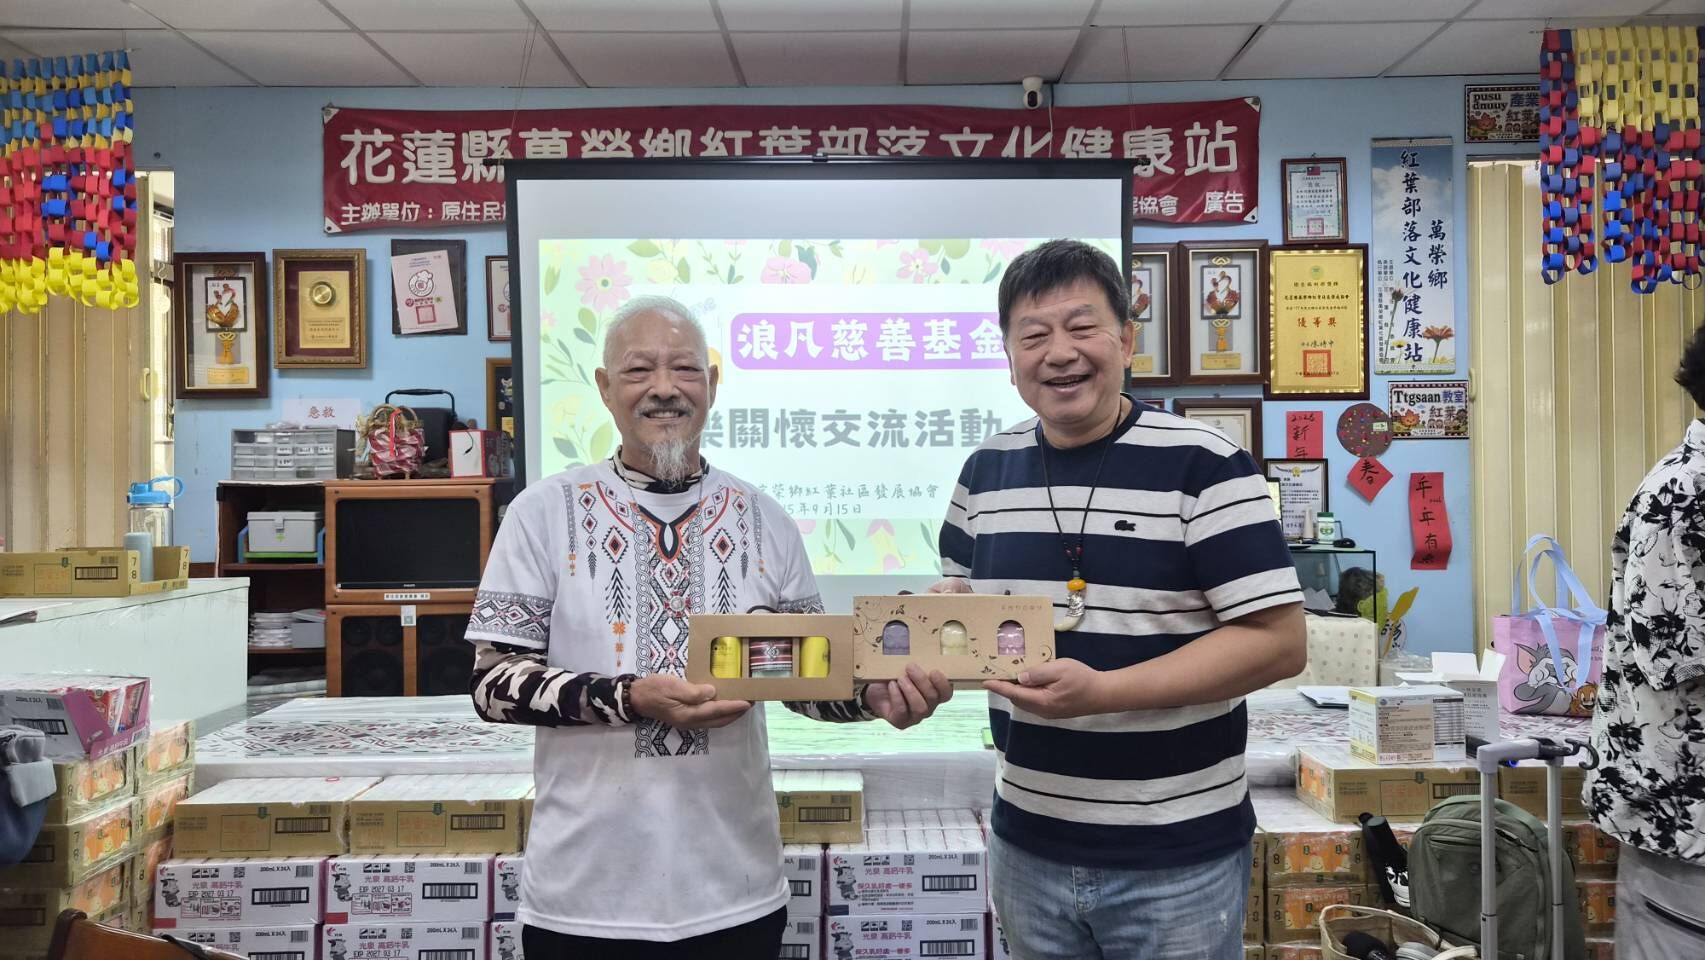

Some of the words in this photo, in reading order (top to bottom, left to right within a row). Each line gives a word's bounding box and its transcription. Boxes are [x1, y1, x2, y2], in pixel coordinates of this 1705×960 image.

[1474, 93, 1501, 102] pusu
[1203, 190, 1244, 214] 廣告
[341, 201, 506, 226] 主辦單位：原住民
[1401, 150, 1423, 362] 紅葉部落文化健康站
[1428, 219, 1448, 289] 萬榮鄉
[738, 318, 1003, 362] 浪凡慈善基金
[1393, 390, 1441, 406] Ttgsaan
[1442, 390, 1464, 403] 教室
[307, 406, 335, 418] 急救
[1429, 405, 1457, 418] 紅葉
[1360, 459, 1379, 485] 春
[131, 557, 137, 566] 7
[131, 570, 137, 579] 8
[1274, 838, 1281, 849] 7
[1355, 838, 1361, 849] 7
[1273, 855, 1281, 865] 8
[1354, 854, 1361, 864] 8
[1274, 894, 1281, 905] 7
[1274, 910, 1281, 921] 8
